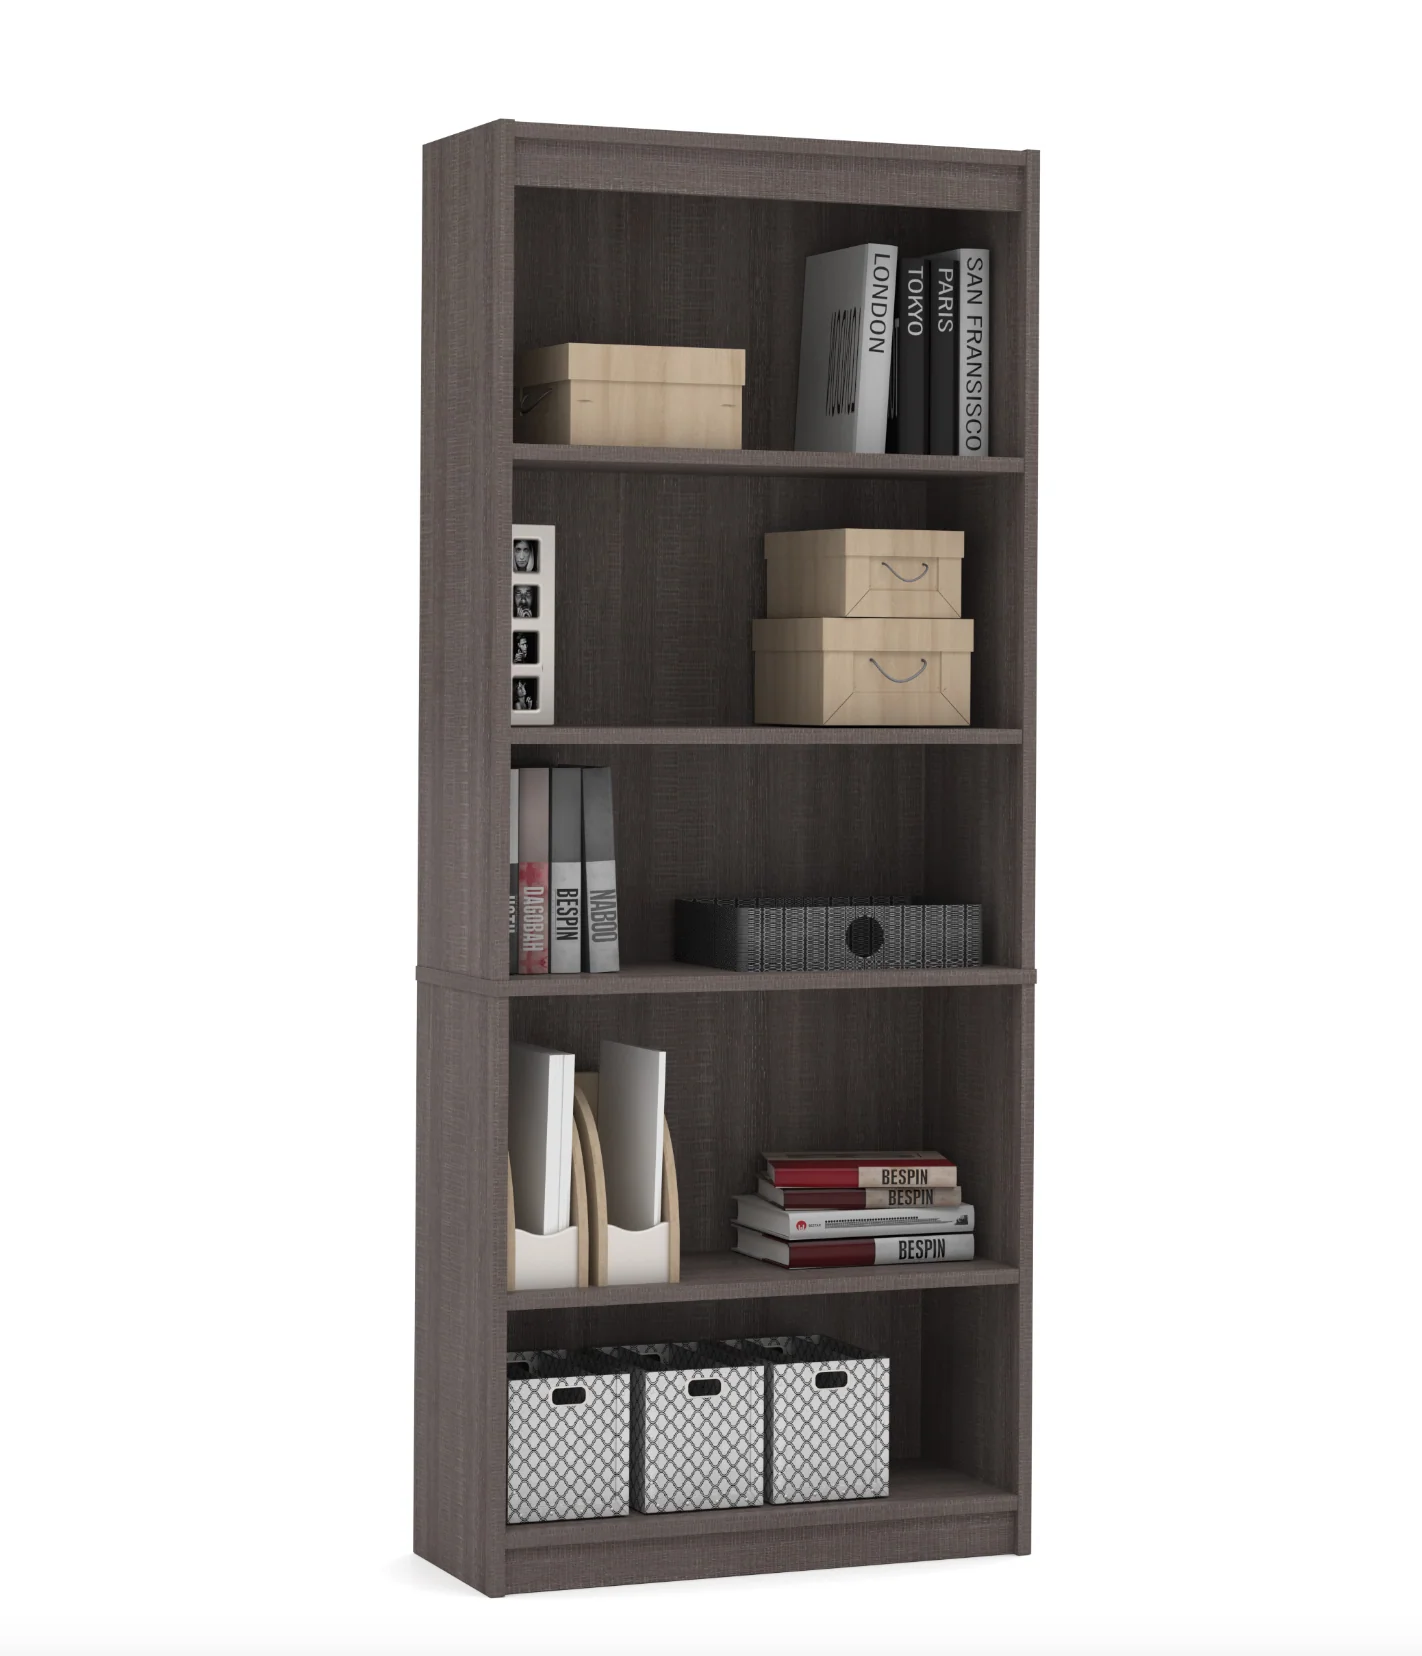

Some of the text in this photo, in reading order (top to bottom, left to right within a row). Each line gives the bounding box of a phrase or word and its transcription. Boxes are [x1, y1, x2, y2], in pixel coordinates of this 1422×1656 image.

[868, 252, 891, 354] LONDON
[907, 265, 924, 337] TOKYO
[937, 268, 954, 333] PARIS
[965, 256, 984, 452] SAN FRANSISCO
[522, 886, 545, 952] DAGOBAH
[556, 888, 579, 941] BESPIN
[589, 888, 618, 943] NABOO
[881, 1168, 928, 1185] BESPIN
[888, 1188, 934, 1206] BESPIN
[898, 1237, 946, 1260] BESPIN
